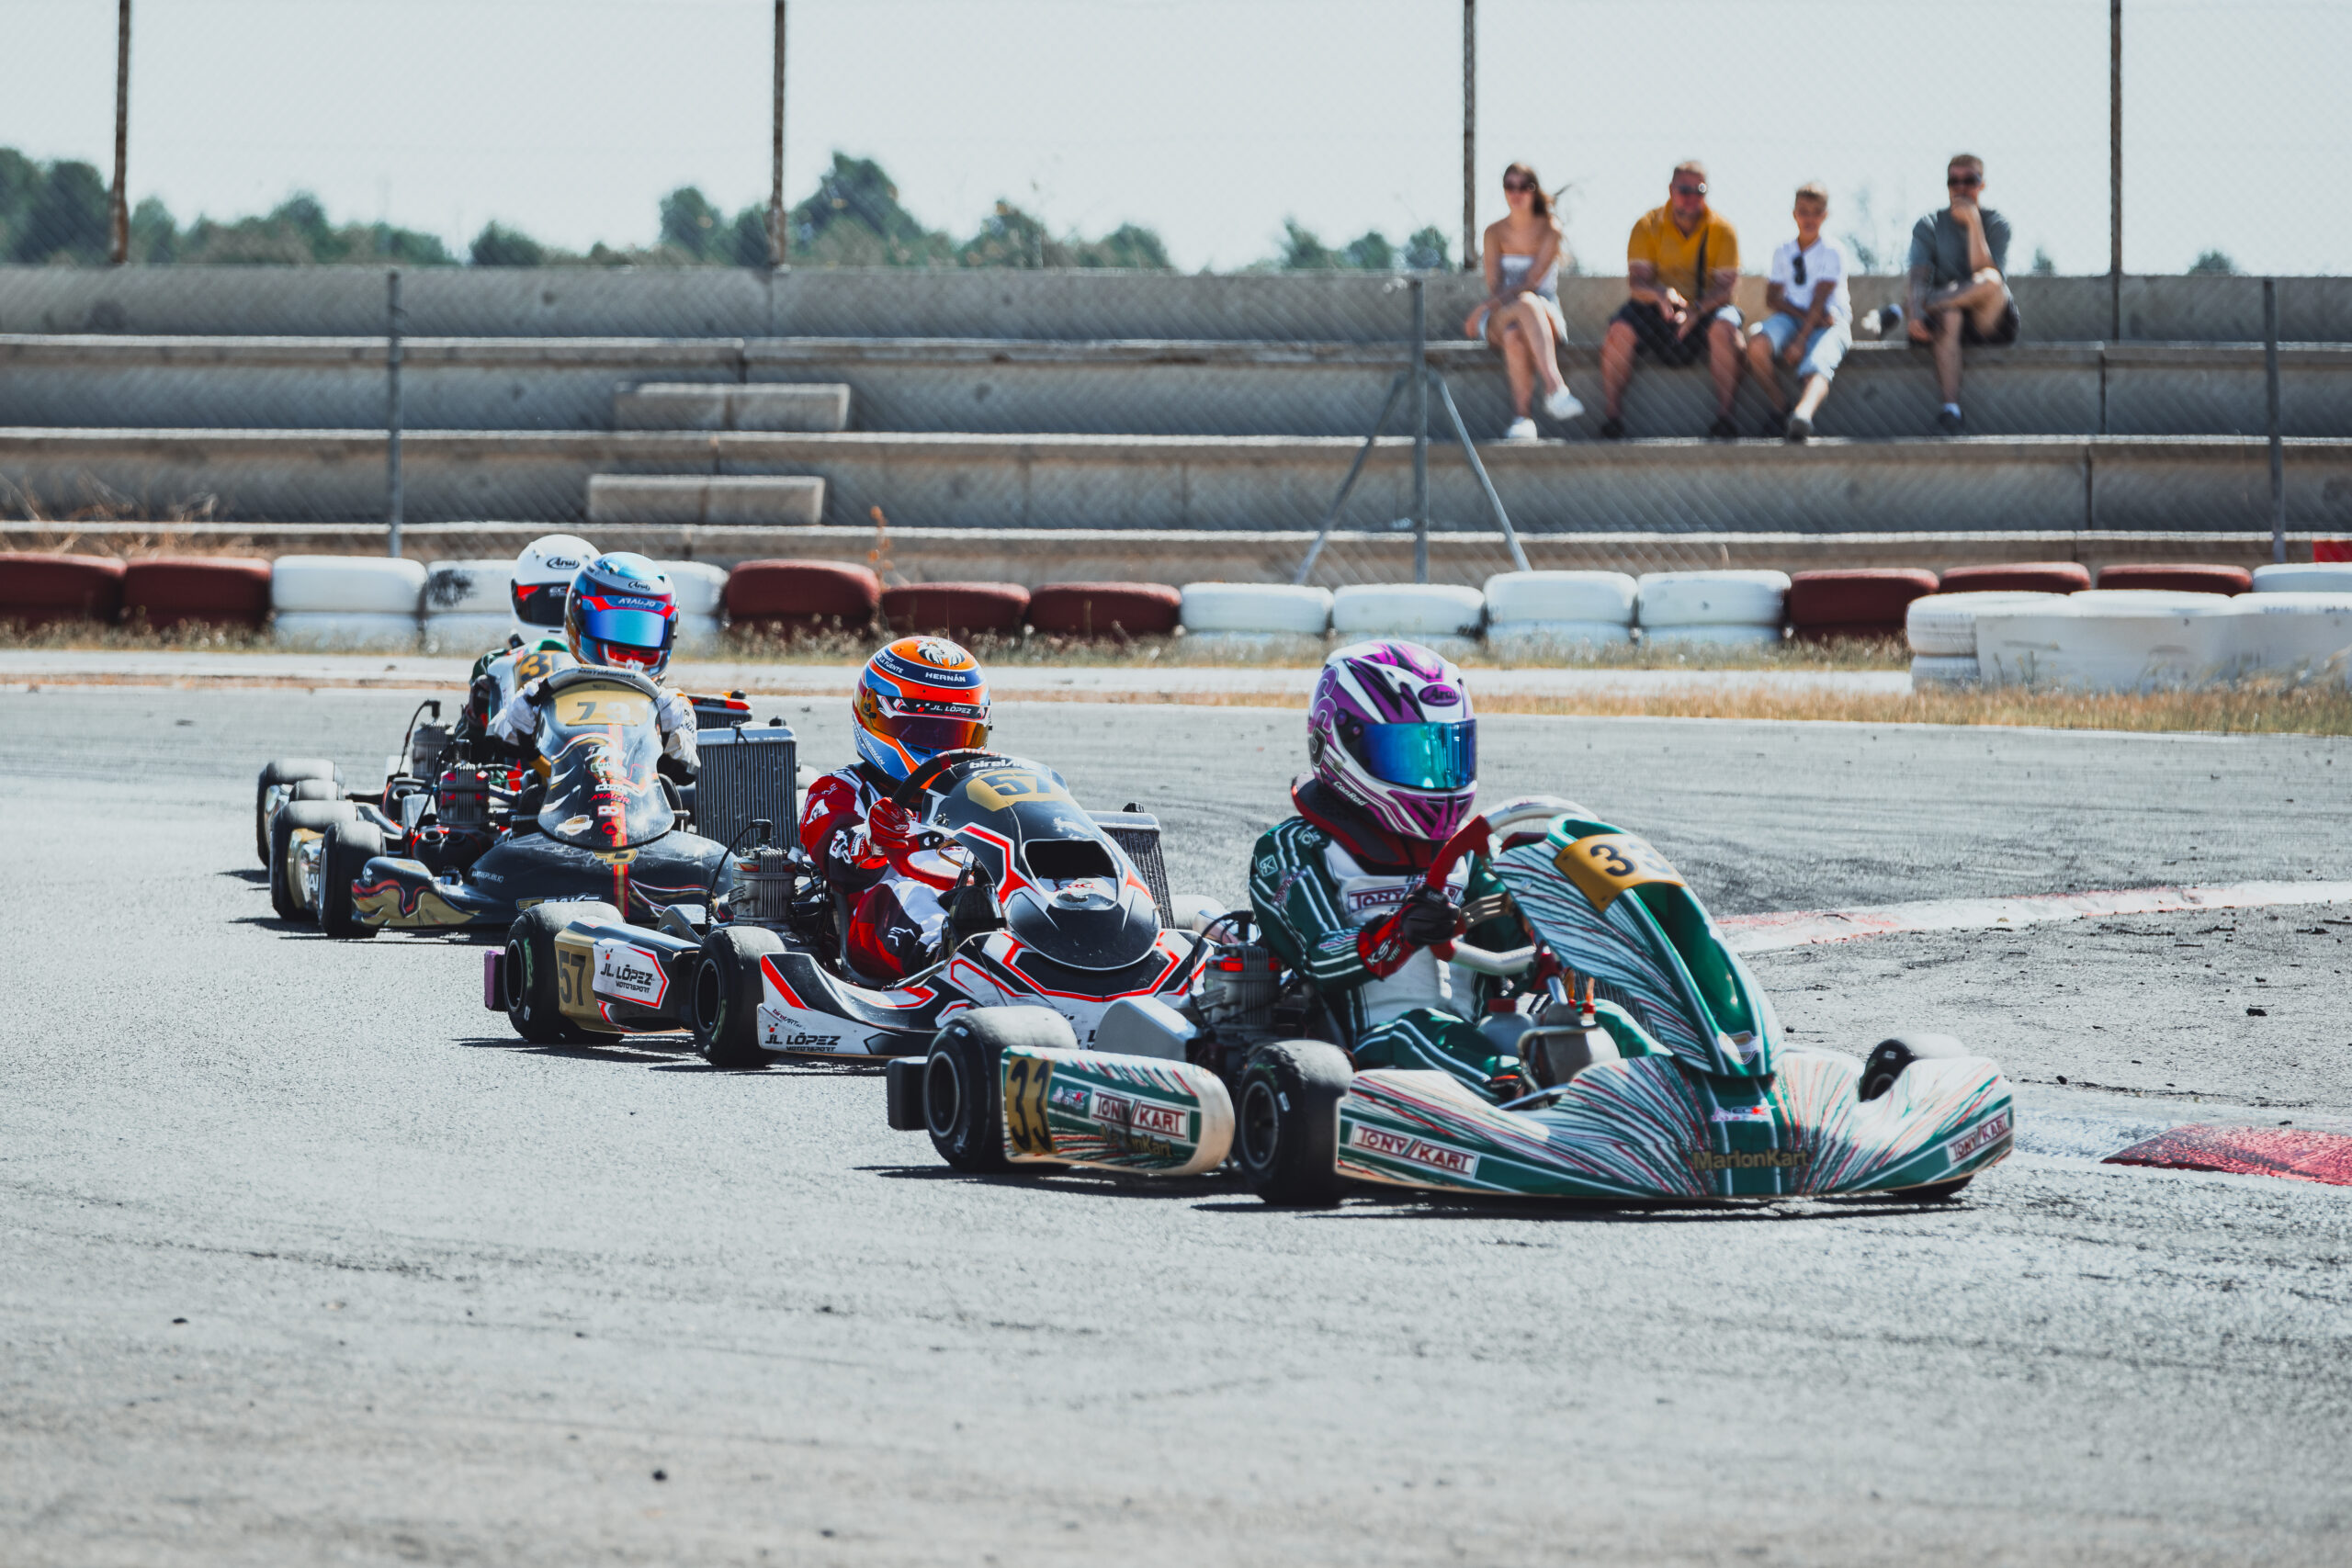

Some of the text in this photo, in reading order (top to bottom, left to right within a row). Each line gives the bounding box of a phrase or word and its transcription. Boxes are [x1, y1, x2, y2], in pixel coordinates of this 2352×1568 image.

[547, 557, 580, 569] Arai
[618, 598, 656, 607] ARAUJO
[885, 660, 904, 673] FUENTE
[925, 671, 967, 682] HERNÁN
[576, 702, 631, 721] 73
[980, 773, 1051, 795] 57
[1333, 781, 1368, 807] ConRod
[1351, 887, 1407, 910] TONY
[559, 950, 586, 1006] 57
[617, 964, 653, 986] LÓPEZ
[616, 981, 650, 993] MOTORSPORT
[786, 1032, 841, 1046] LÓPEZ
[1012, 1059, 1053, 1152] 33
[1095, 1092, 1132, 1123] TONY
[1139, 1103, 1186, 1133] KART
[1950, 1111, 2007, 1158] TONY KART
[1359, 1126, 1475, 1170] TONY KART
[1693, 1149, 1810, 1169] MarlonKart
